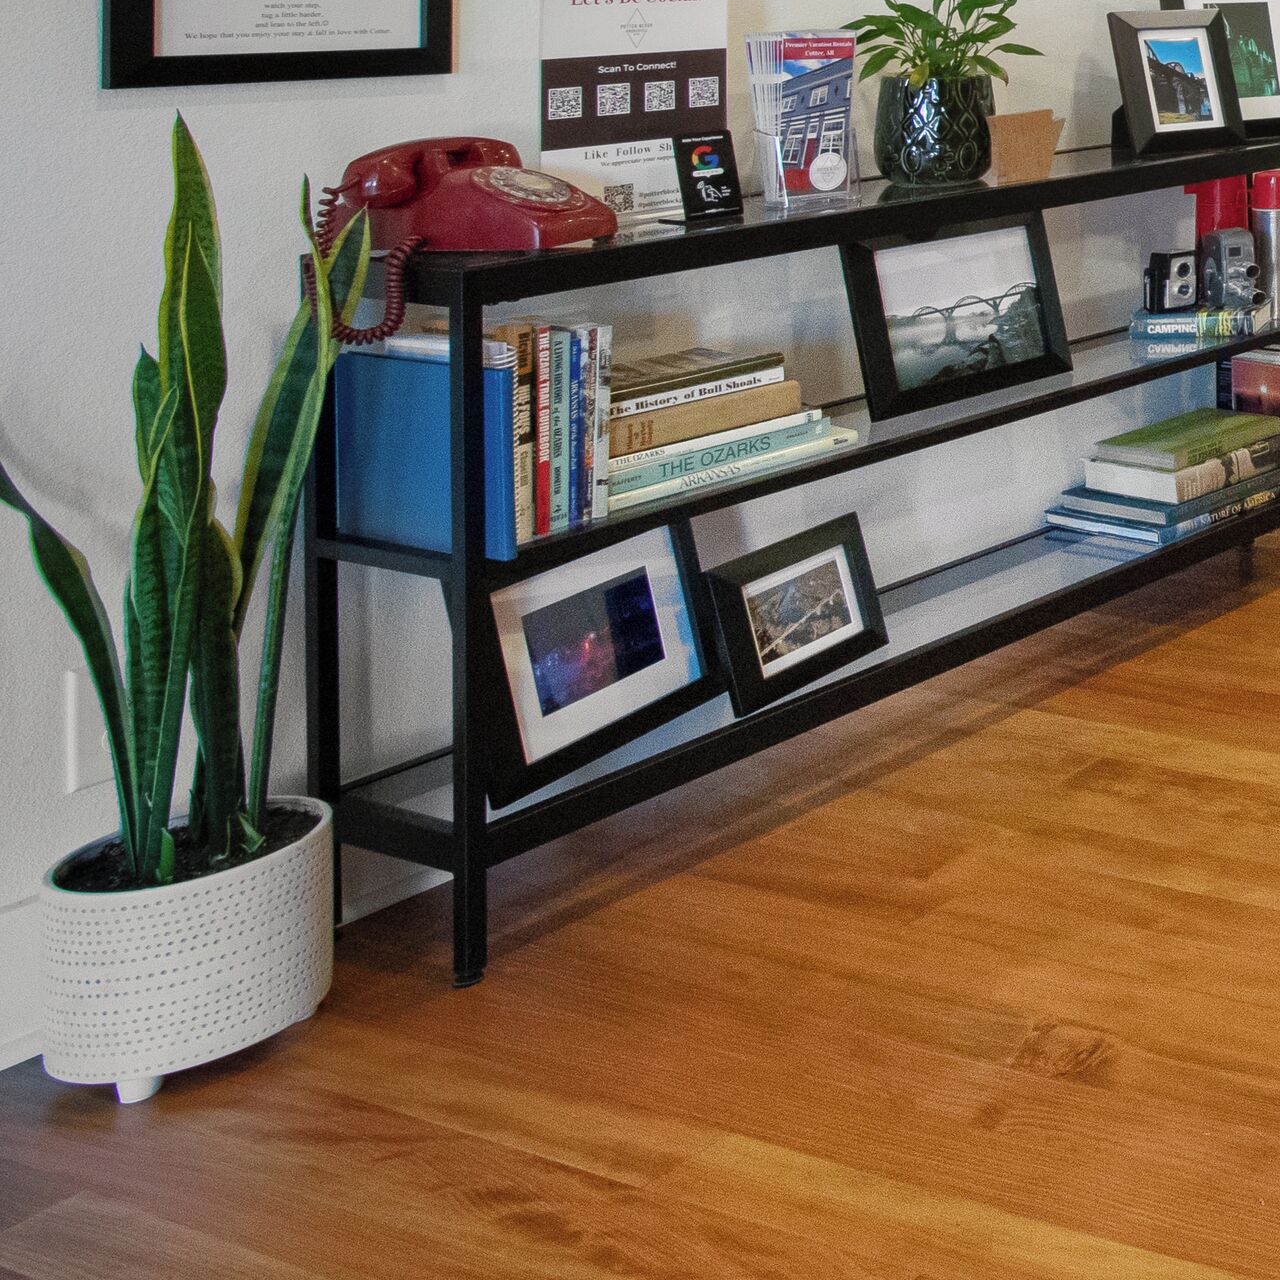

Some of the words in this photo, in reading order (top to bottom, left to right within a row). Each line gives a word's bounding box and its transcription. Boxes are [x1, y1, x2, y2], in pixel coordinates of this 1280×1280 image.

[785, 41, 808, 49] Premier
[598, 65, 621, 74] Scan
[623, 64, 635, 72] To
[637, 61, 677, 71] Connect!
[584, 151, 608, 160] Like
[616, 147, 651, 156] Follow
[659, 143, 673, 152] Sh
[1148, 324, 1196, 333] CAMPING
[539, 332, 549, 351] THE
[539, 352, 549, 380] OZARK
[554, 347, 563, 372] LIVING
[539, 381, 549, 408] TRAIL
[554, 373, 563, 404] HISTORY
[610, 405, 631, 417] The
[635, 396, 679, 411] History
[684, 390, 696, 400] of
[699, 385, 722, 397] Bull
[726, 377, 762, 391] Shoals
[553, 407, 562, 415] of
[553, 416, 562, 427] the
[539, 410, 549, 463] GUIDEBOOK
[554, 428, 563, 458] OZARKS
[633, 449, 665, 462] OZARKS
[658, 457, 695, 478] THE
[700, 436, 771, 466] OZARKS
[680, 464, 741, 488] ARKANSAS
[1231, 504, 1242, 515] OF
